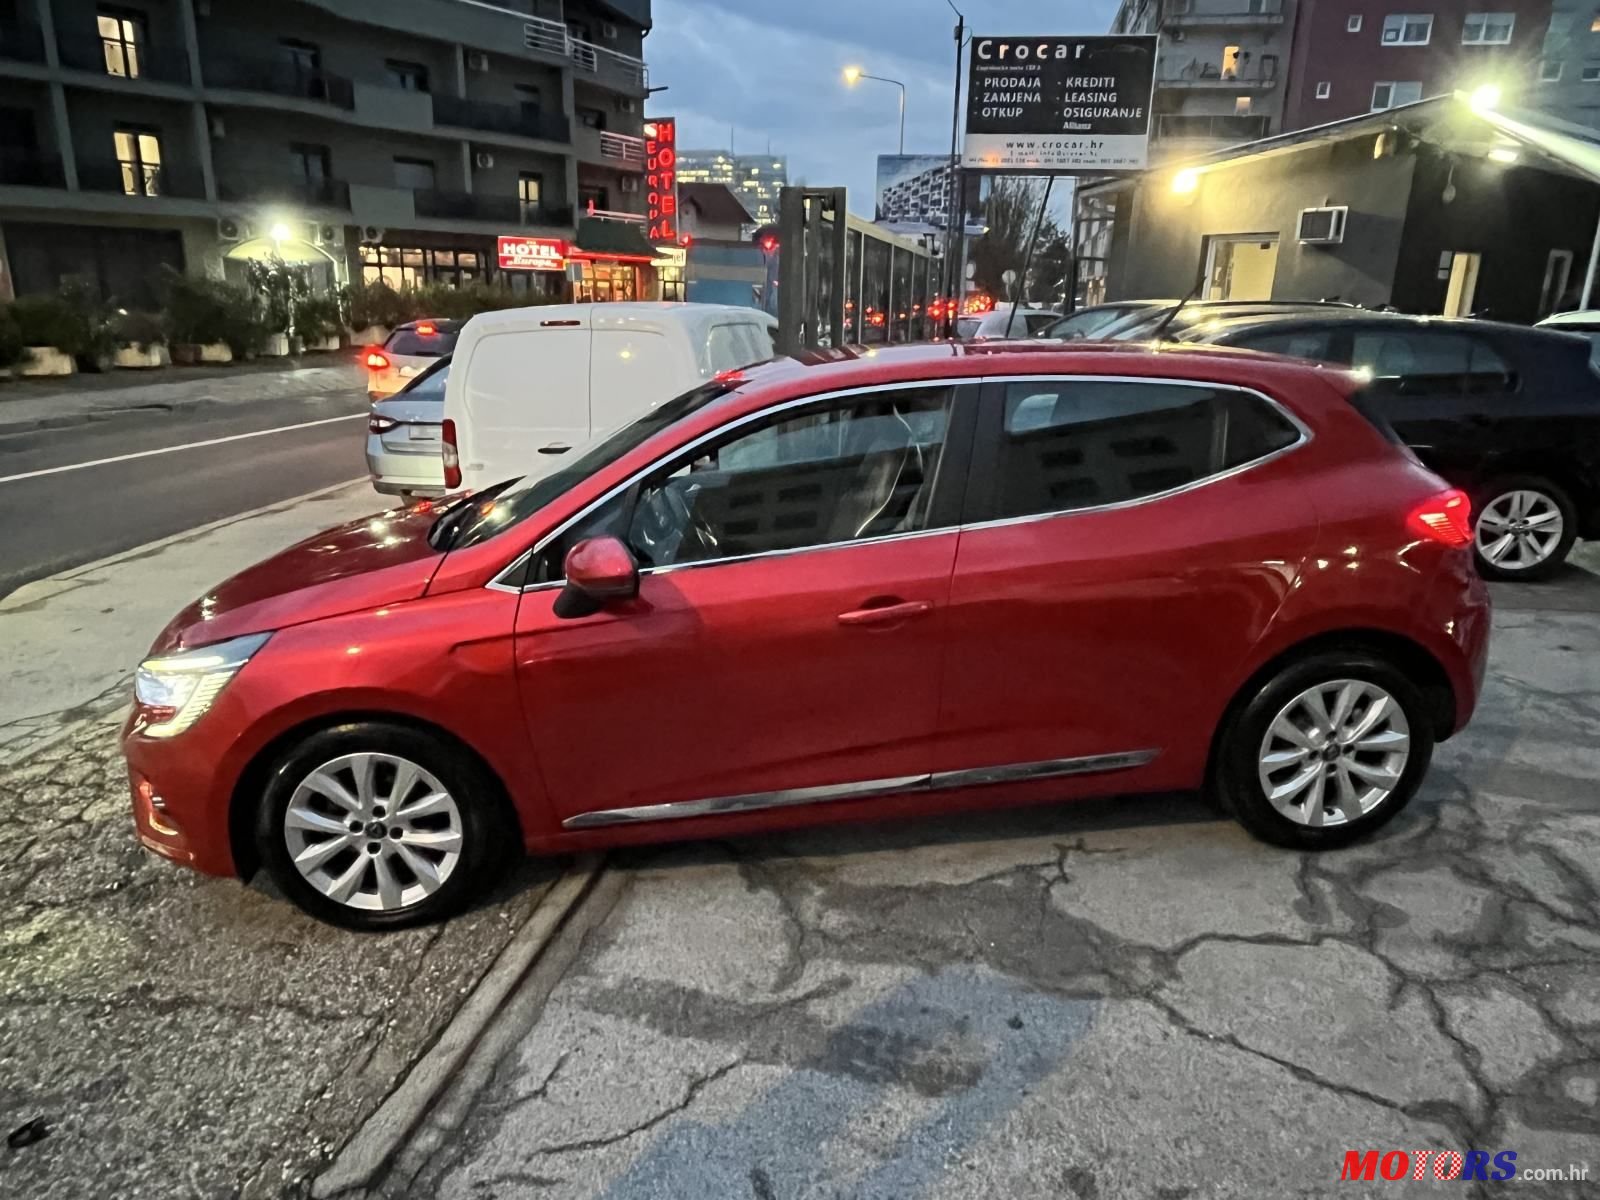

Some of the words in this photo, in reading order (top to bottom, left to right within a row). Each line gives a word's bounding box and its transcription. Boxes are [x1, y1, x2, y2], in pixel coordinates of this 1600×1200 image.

[977, 40, 1086, 60] Crocar
[984, 77, 1041, 88] PRODAJA
[1065, 77, 1115, 88] KREDITI
[983, 92, 1042, 103] ZAMJENA
[1064, 92, 1117, 103] LEASING
[981, 107, 1023, 118] OTKUP
[1063, 107, 1142, 118] OSIGURANJE
[1006, 141, 1104, 149] www.crocar.hr
[658, 123, 675, 238] HOTEL
[646, 141, 660, 239] EUROPA
[503, 243, 559, 257] HOTEL
